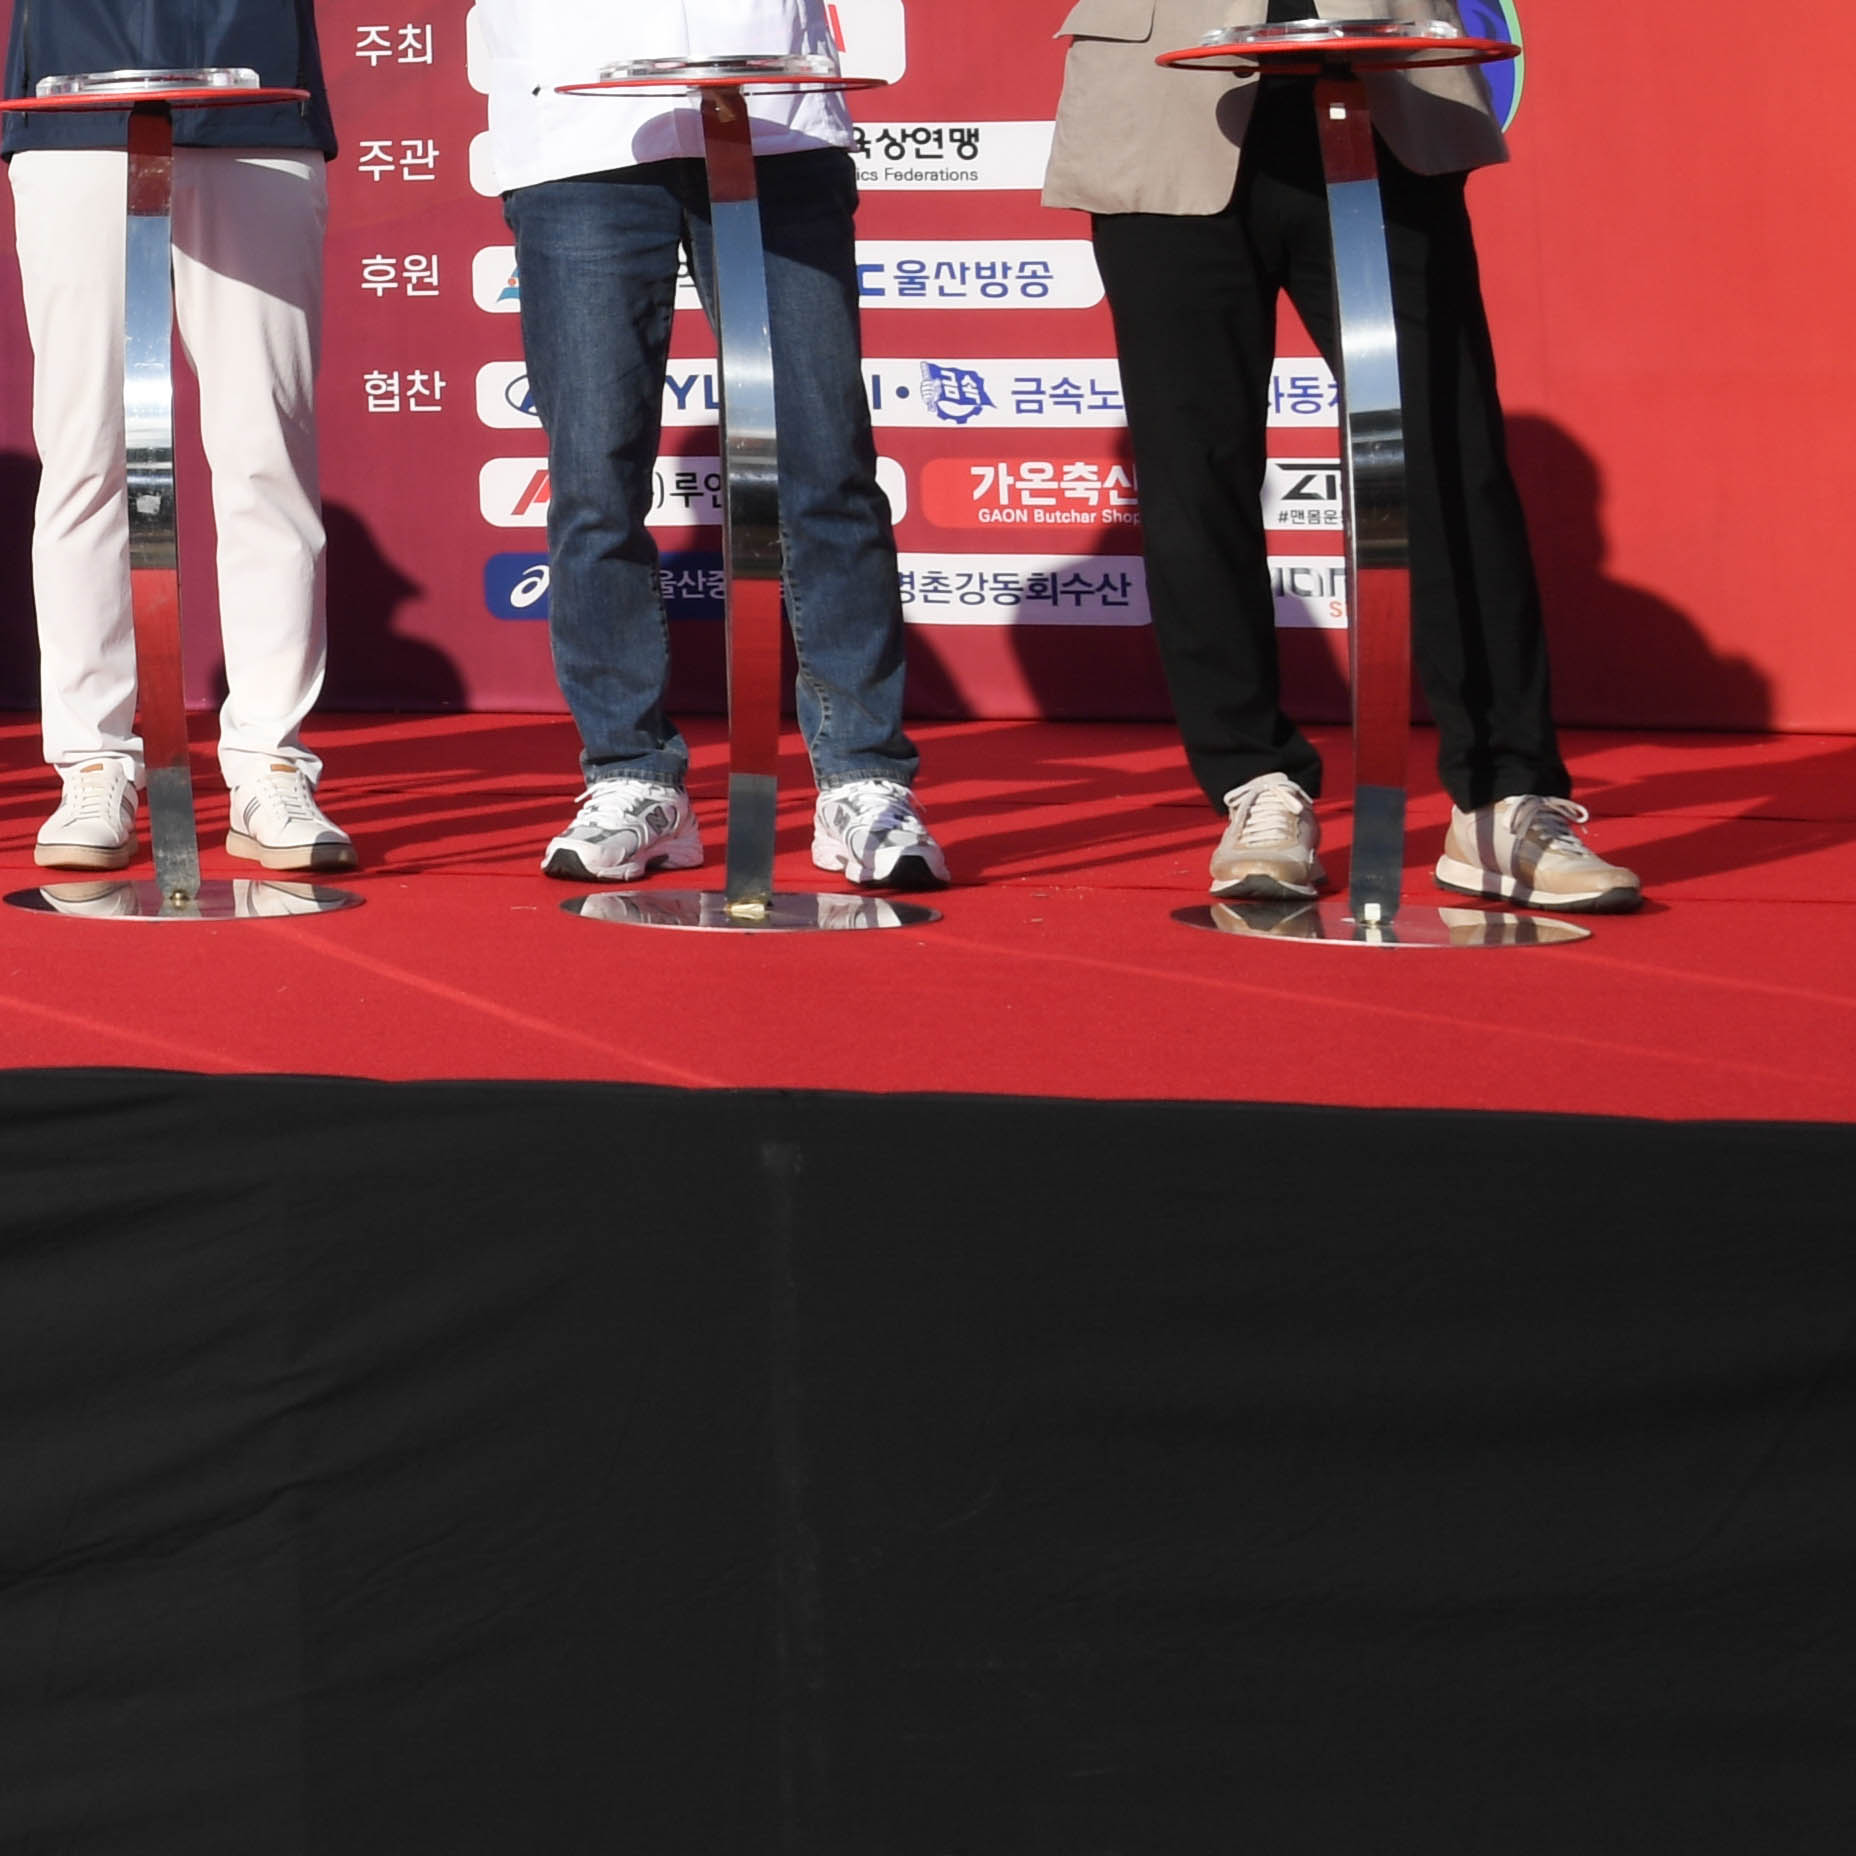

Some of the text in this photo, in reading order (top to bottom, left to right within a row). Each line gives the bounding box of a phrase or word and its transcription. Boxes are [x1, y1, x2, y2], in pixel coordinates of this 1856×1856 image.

[354, 22, 434, 67] 주최
[357, 138, 440, 182] 주관
[884, 166, 979, 182] Federations
[360, 253, 441, 297] 후원
[893, 258, 1054, 299] 울산방송
[363, 368, 447, 413] 협찬
[1010, 374, 1126, 415] 금속노
[978, 508, 1028, 524] GAON
[1278, 509, 1344, 526] #맨몸운
